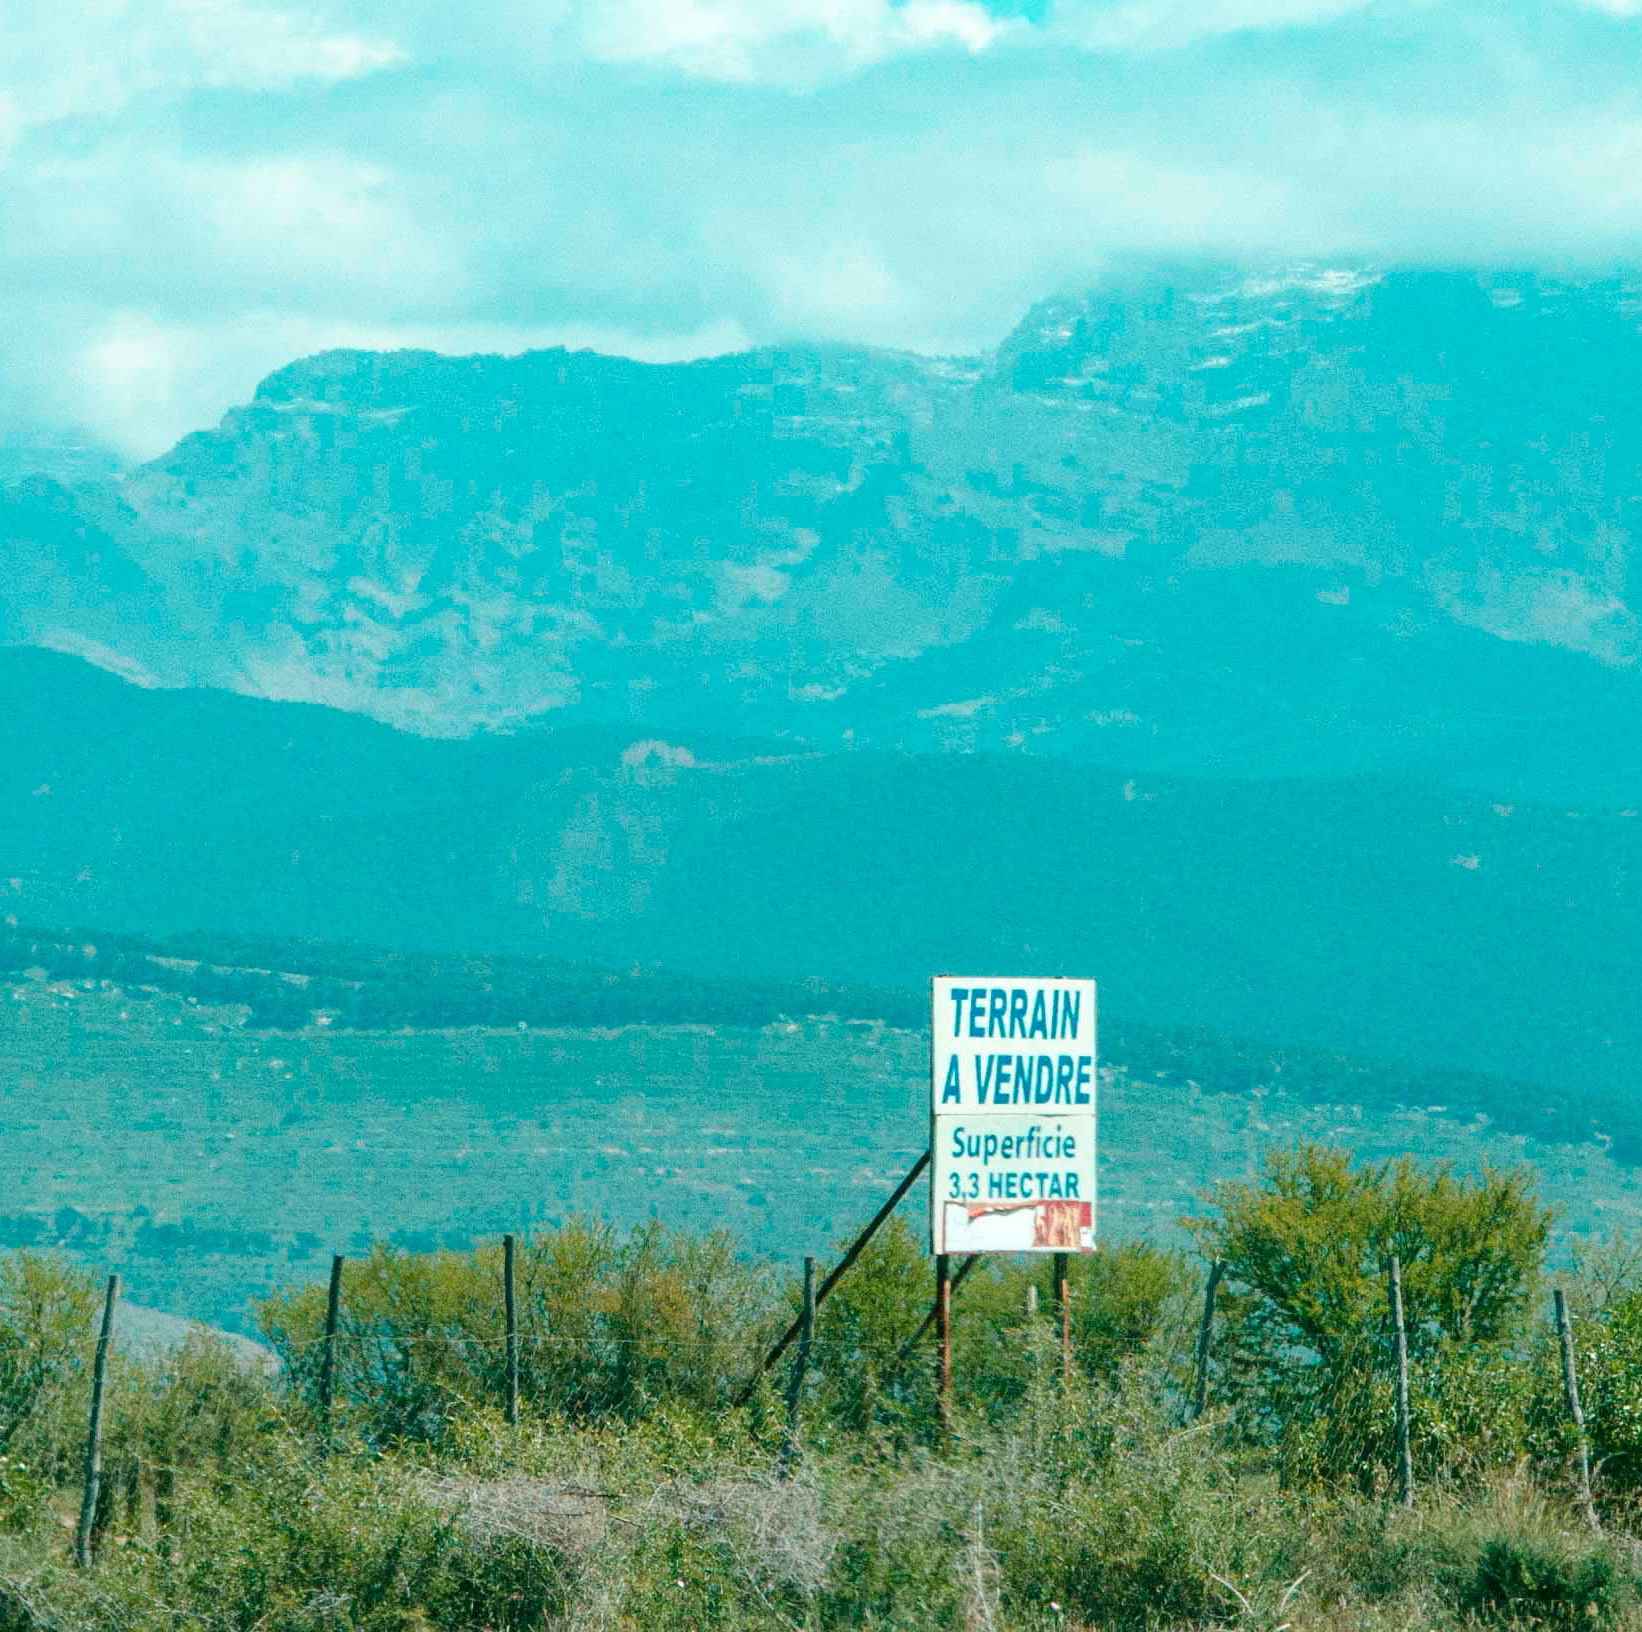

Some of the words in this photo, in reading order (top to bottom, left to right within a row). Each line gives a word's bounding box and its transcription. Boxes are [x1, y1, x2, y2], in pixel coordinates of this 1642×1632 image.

[951, 988, 1080, 1039] TERRAIN
[942, 1054, 961, 1104] A
[975, 1054, 1092, 1105] VENDRE
[952, 1124, 1076, 1165] Superficie
[989, 1172, 1079, 1198] HECTAR
